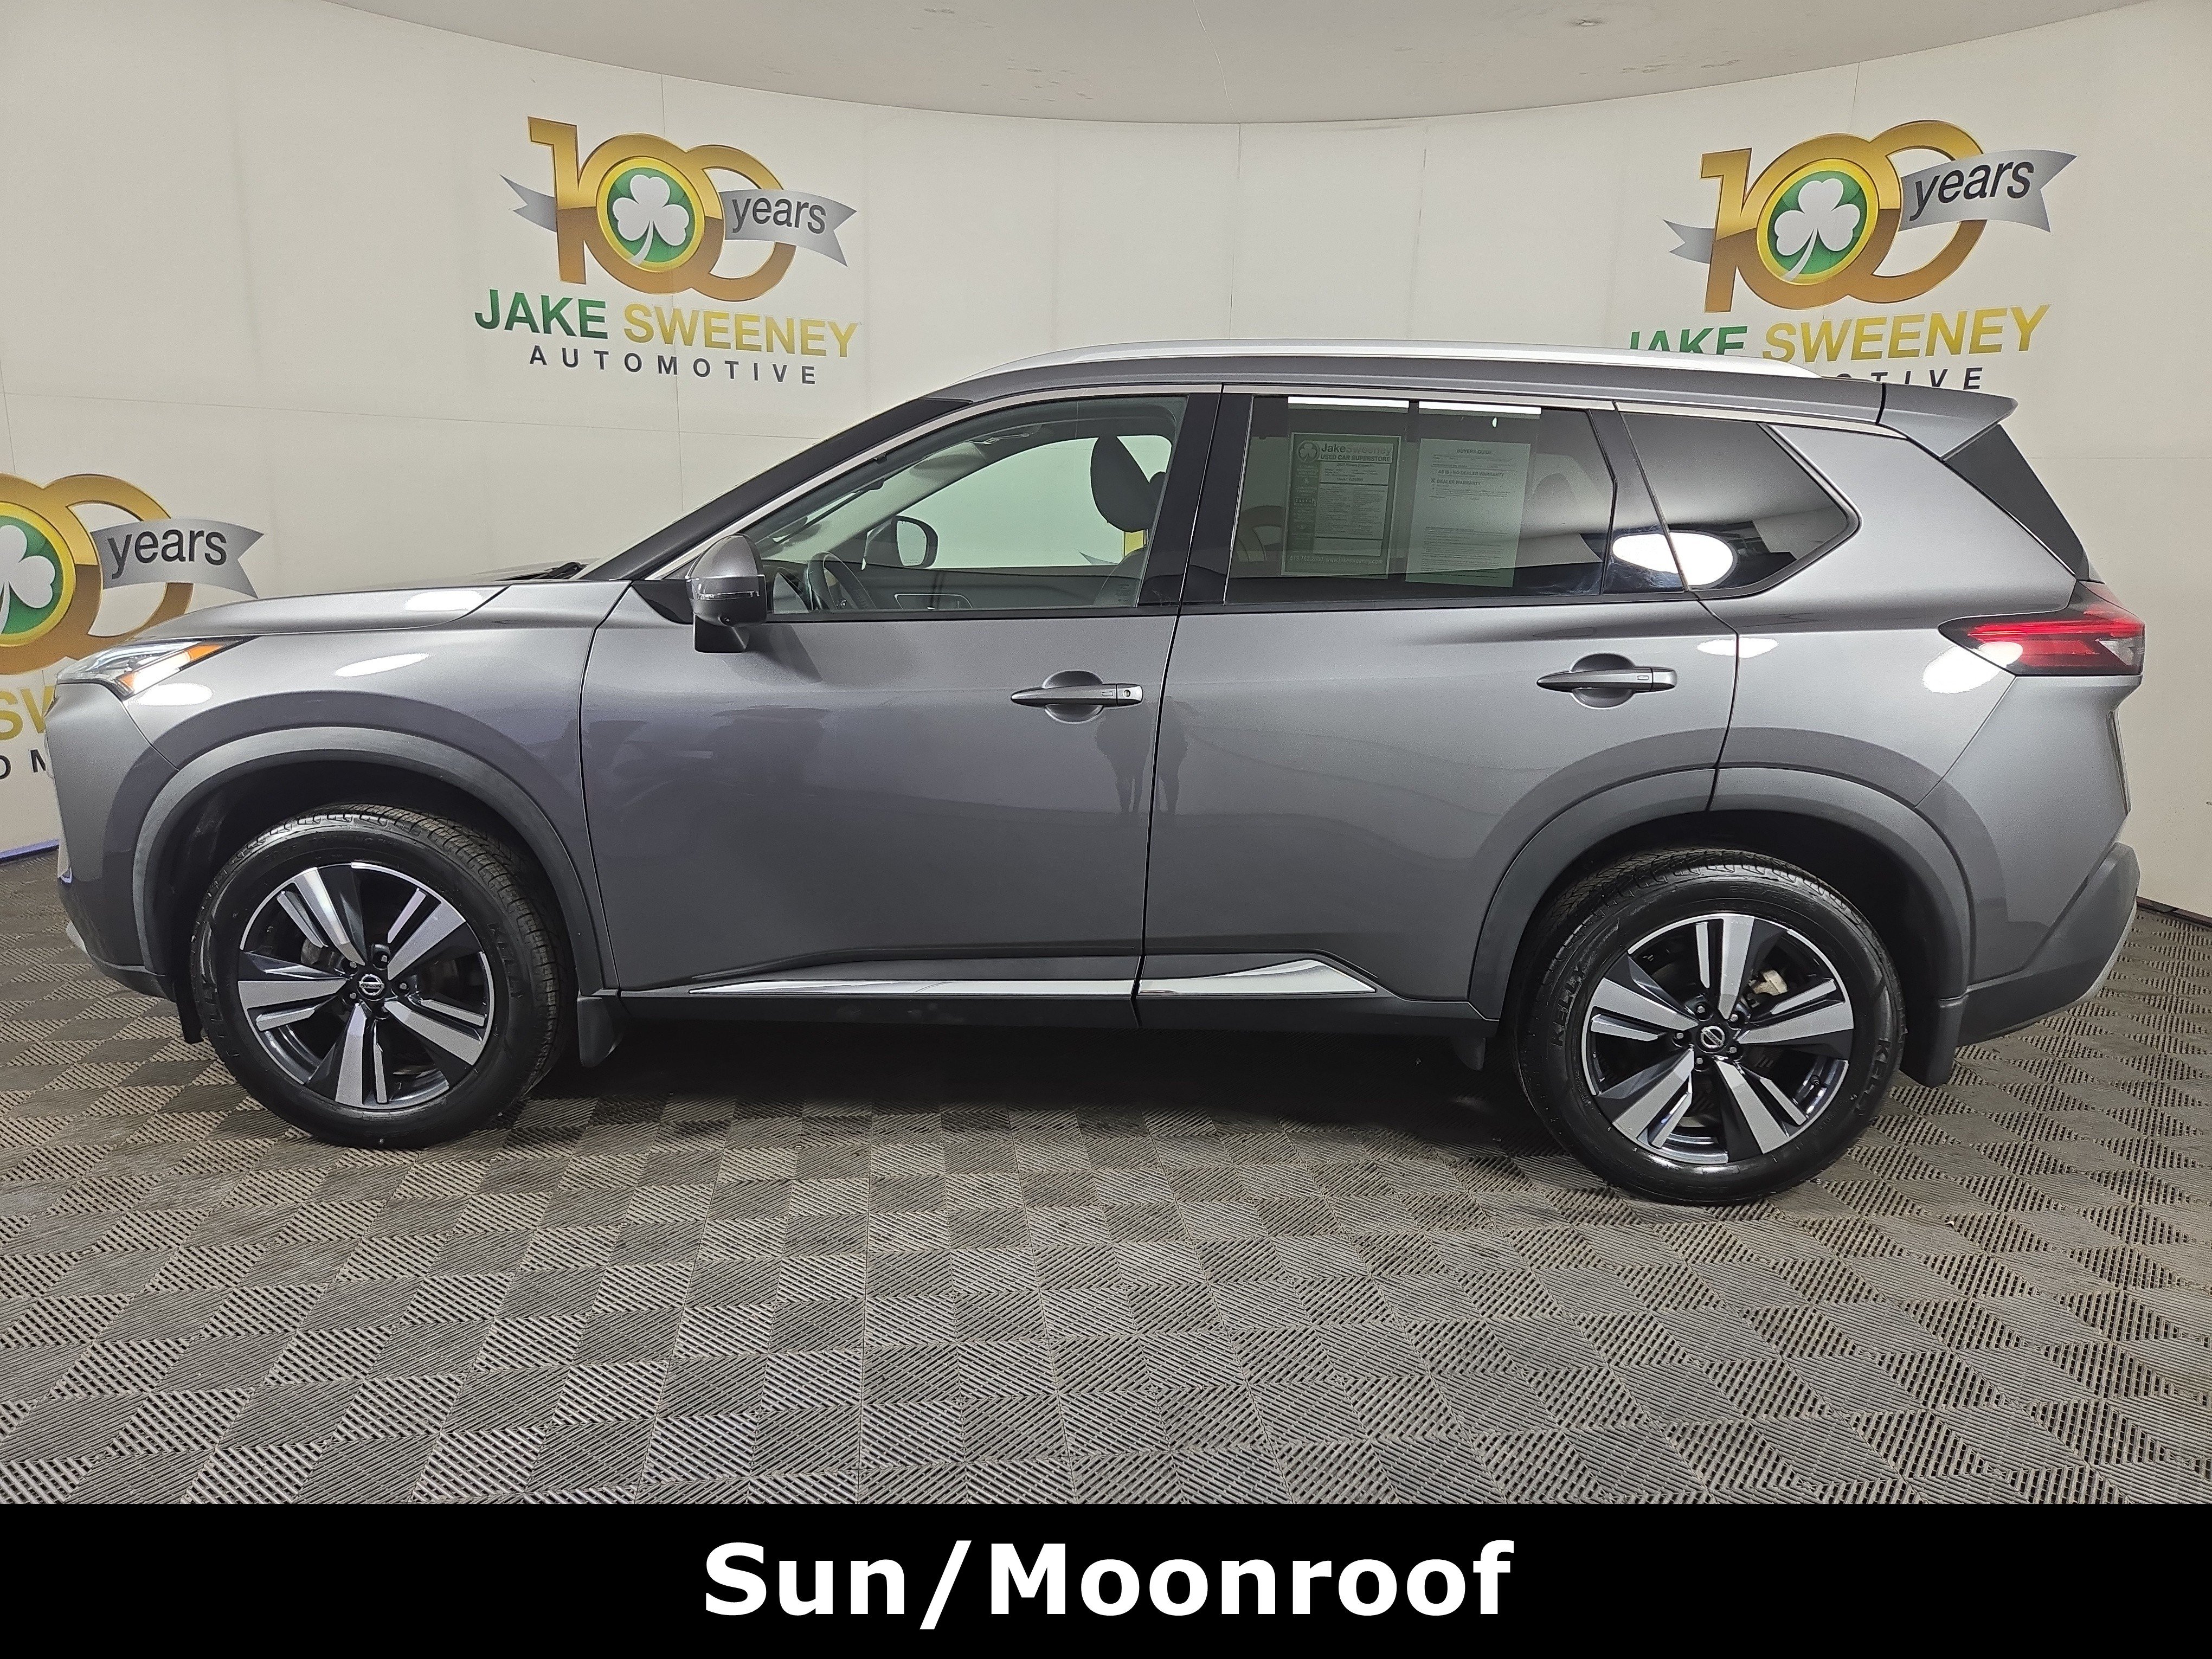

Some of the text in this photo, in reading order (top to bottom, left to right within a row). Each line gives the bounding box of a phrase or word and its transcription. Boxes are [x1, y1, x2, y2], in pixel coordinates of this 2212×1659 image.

[528, 116, 827, 302] 100 years
[1700, 119, 2034, 313] 100 years
[474, 289, 859, 358] JAKE SWEENEY
[1763, 304, 2052, 363] SWEENEY
[530, 345, 816, 385] AUTOMOTIVE
[107, 530, 228, 580] years
[1550, 965, 1585, 1047] KELLY
